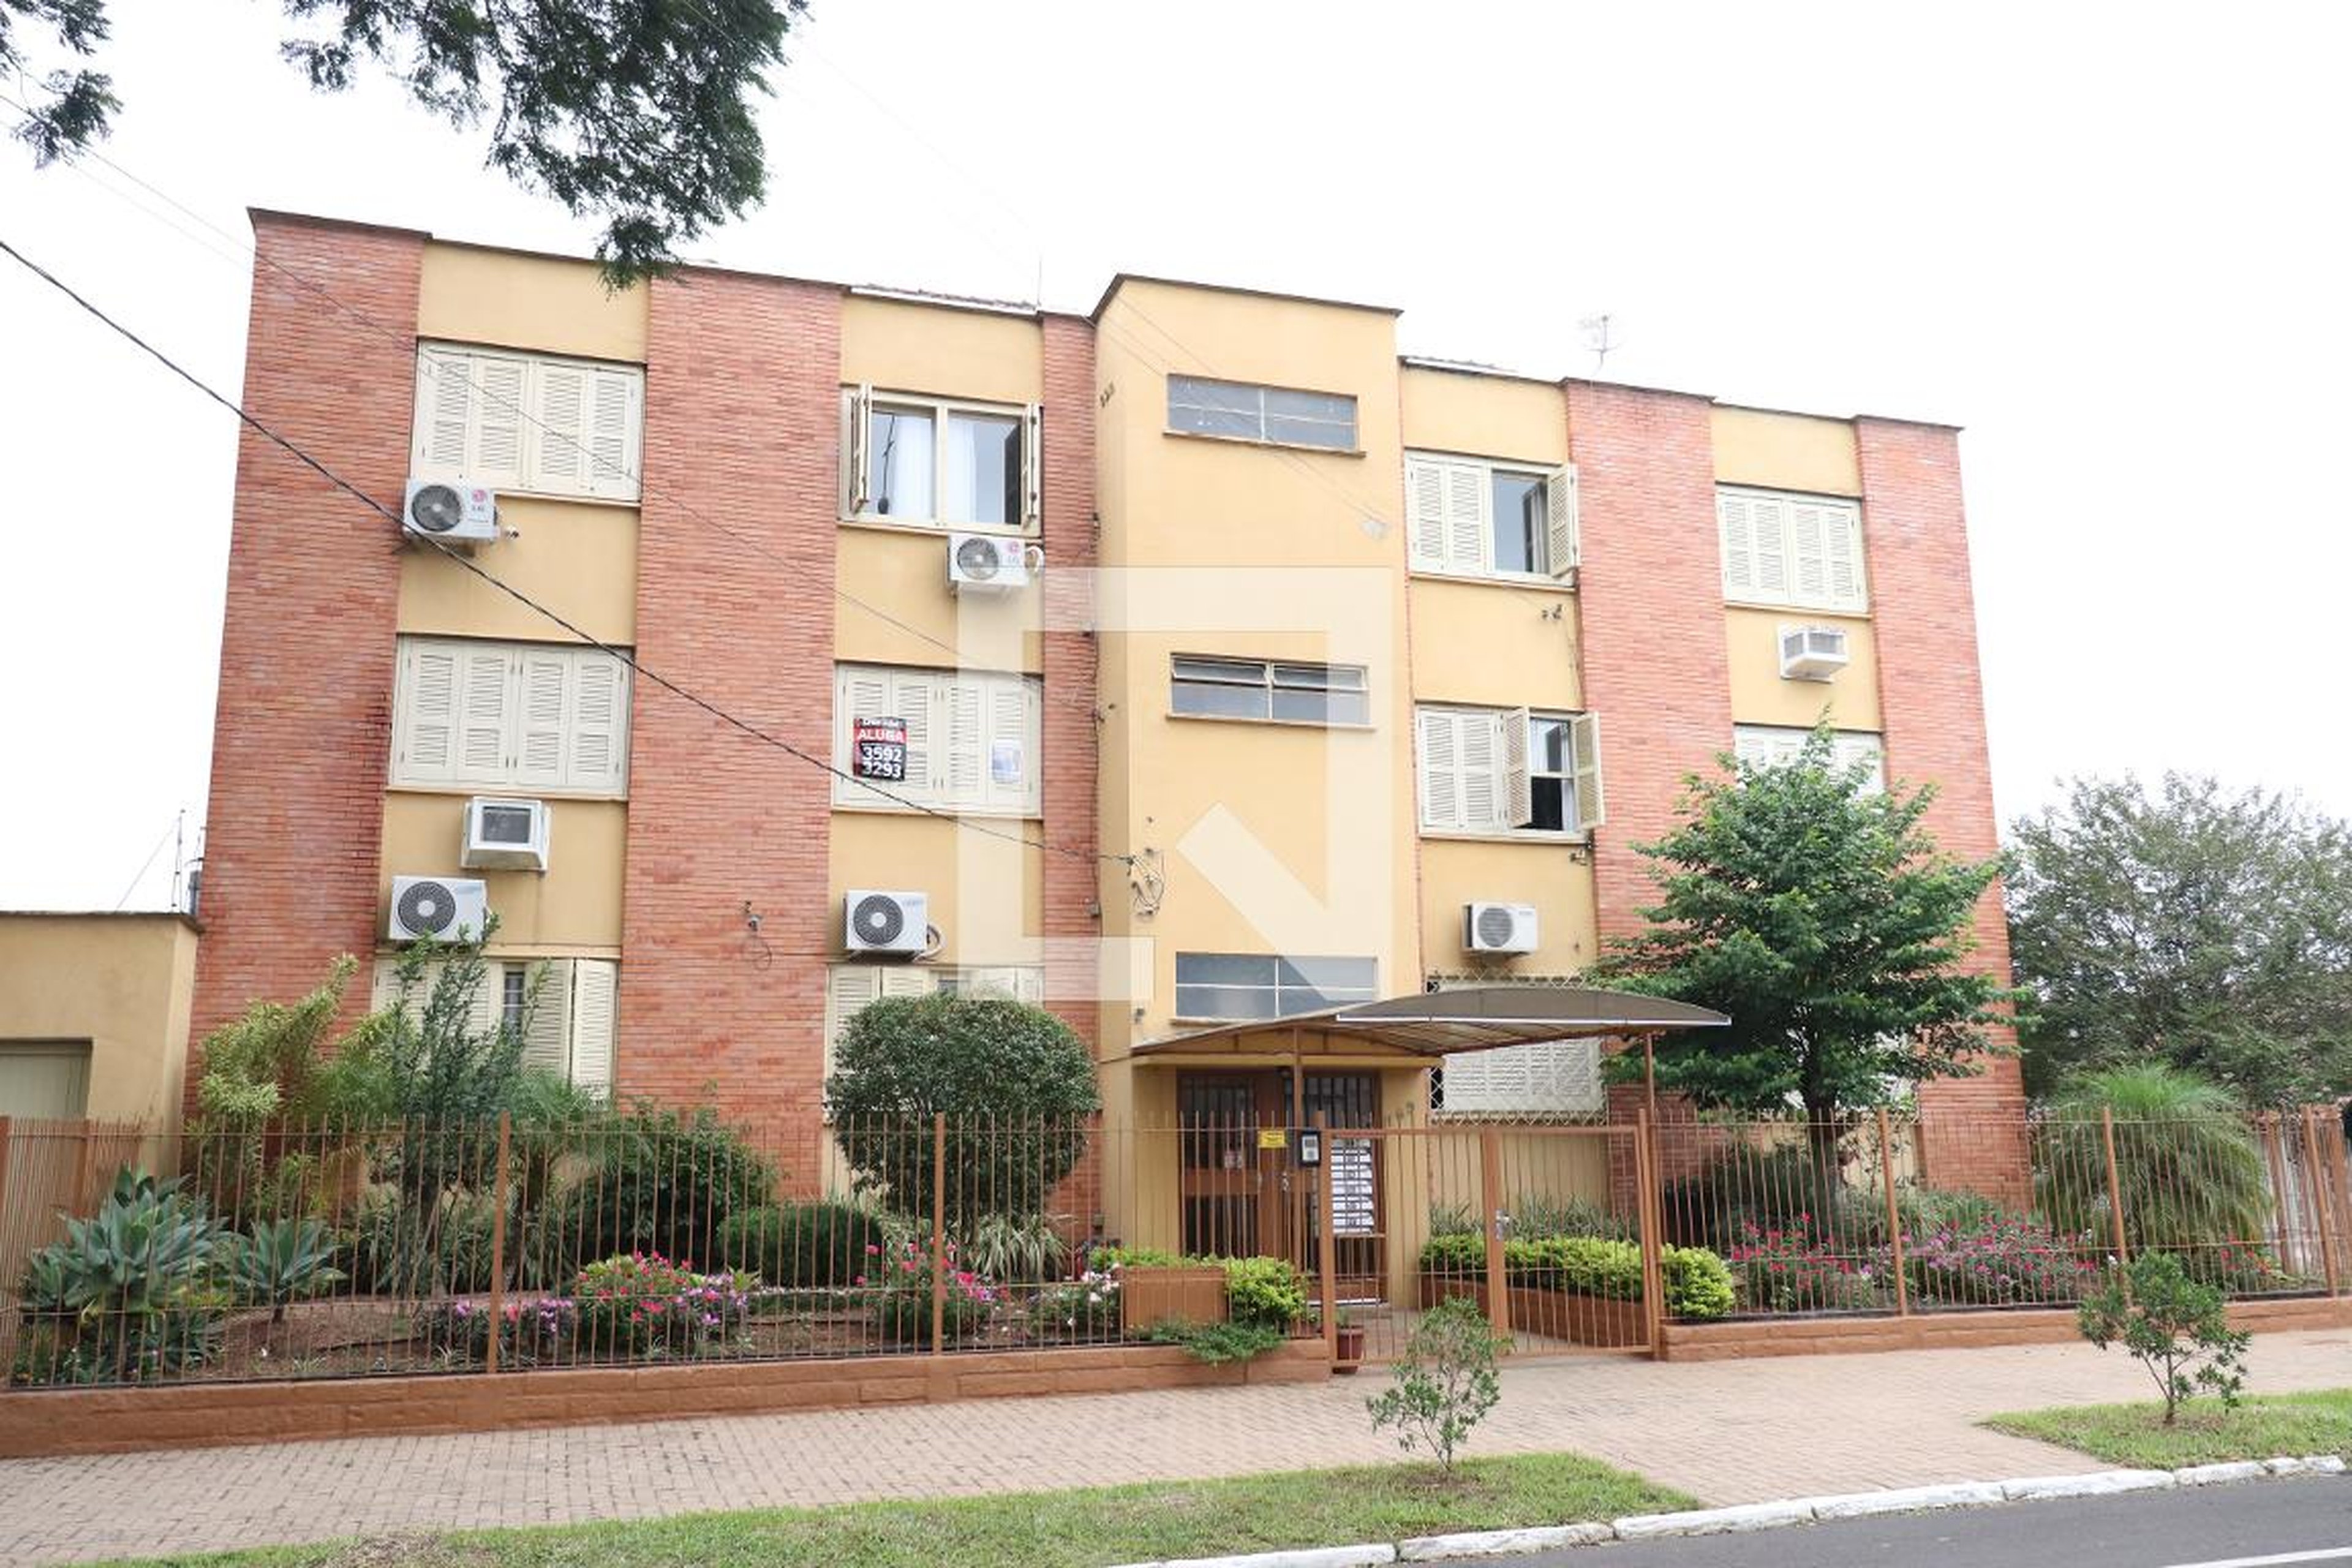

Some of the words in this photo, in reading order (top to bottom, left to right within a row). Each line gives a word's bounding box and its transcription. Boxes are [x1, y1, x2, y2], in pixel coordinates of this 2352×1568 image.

[857, 729, 905, 744] ALUGA
[862, 747, 902, 762] 3592
[862, 762, 901, 778] 3293
